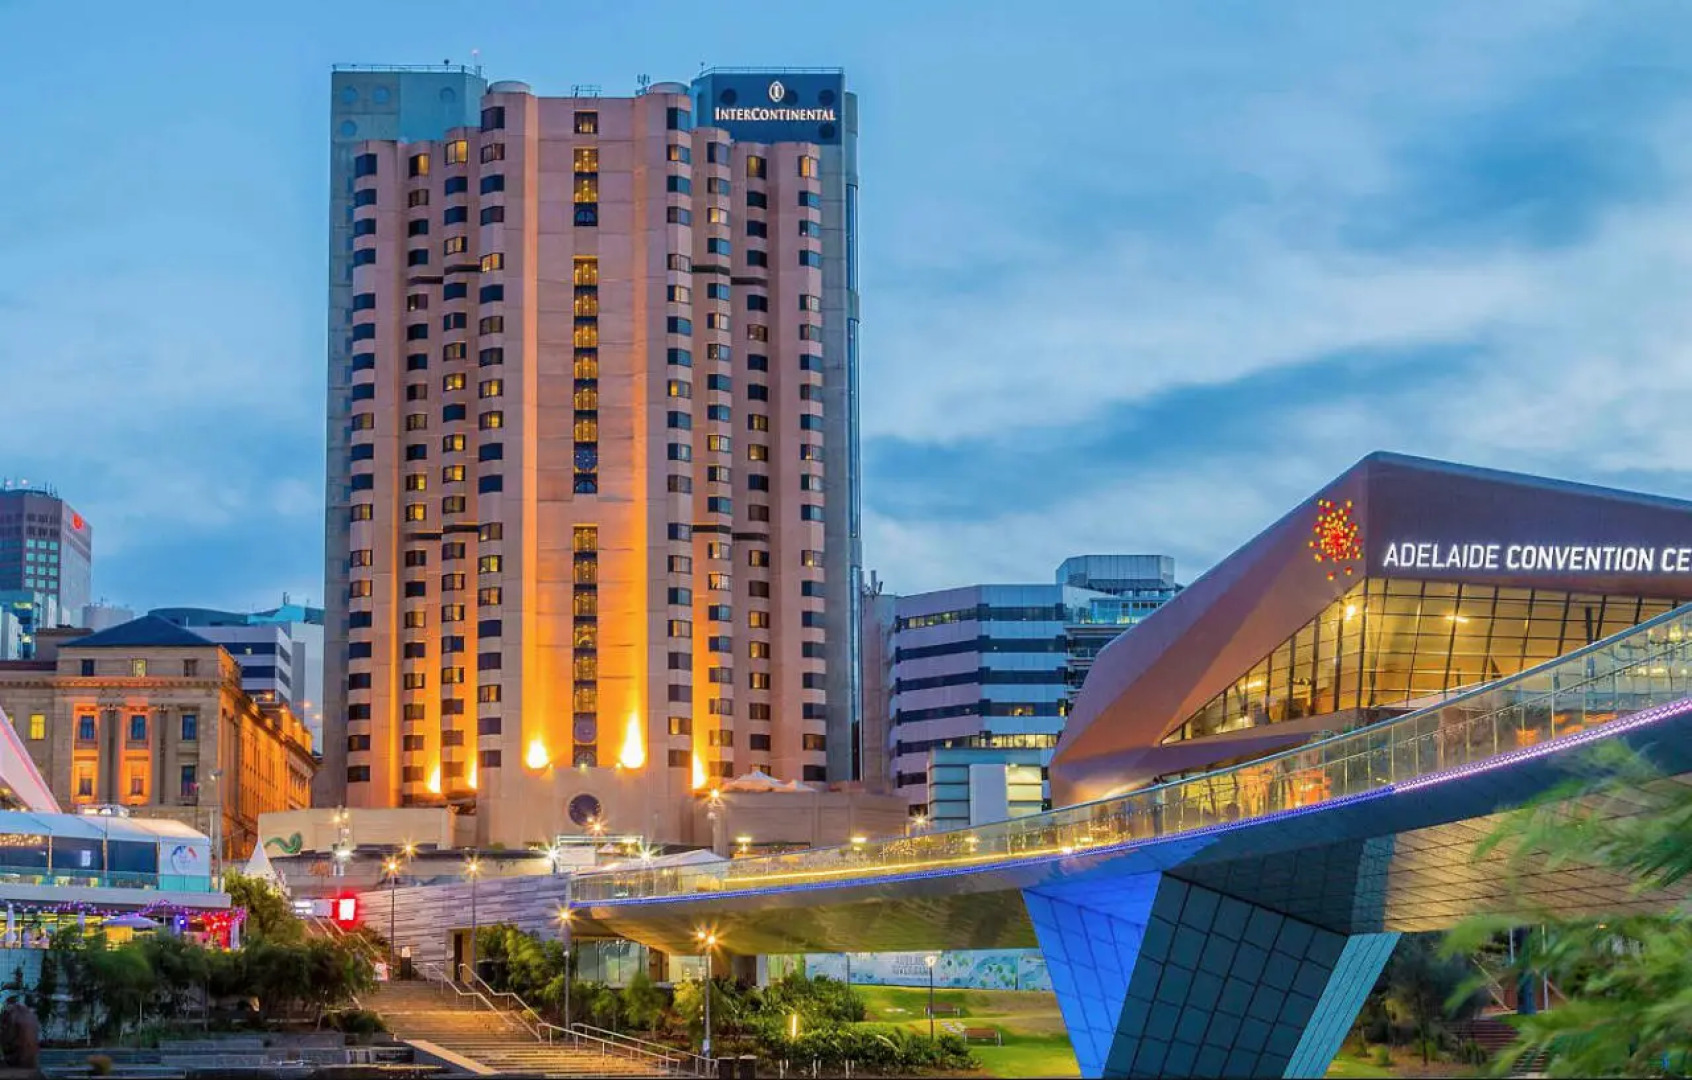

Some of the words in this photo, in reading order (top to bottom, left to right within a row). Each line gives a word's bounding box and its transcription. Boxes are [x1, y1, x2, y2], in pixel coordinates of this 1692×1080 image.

[1383, 542, 1500, 569] ADELAIDE
[1506, 545, 1656, 571] CONVENTION
[1661, 548, 1692, 572] CE
